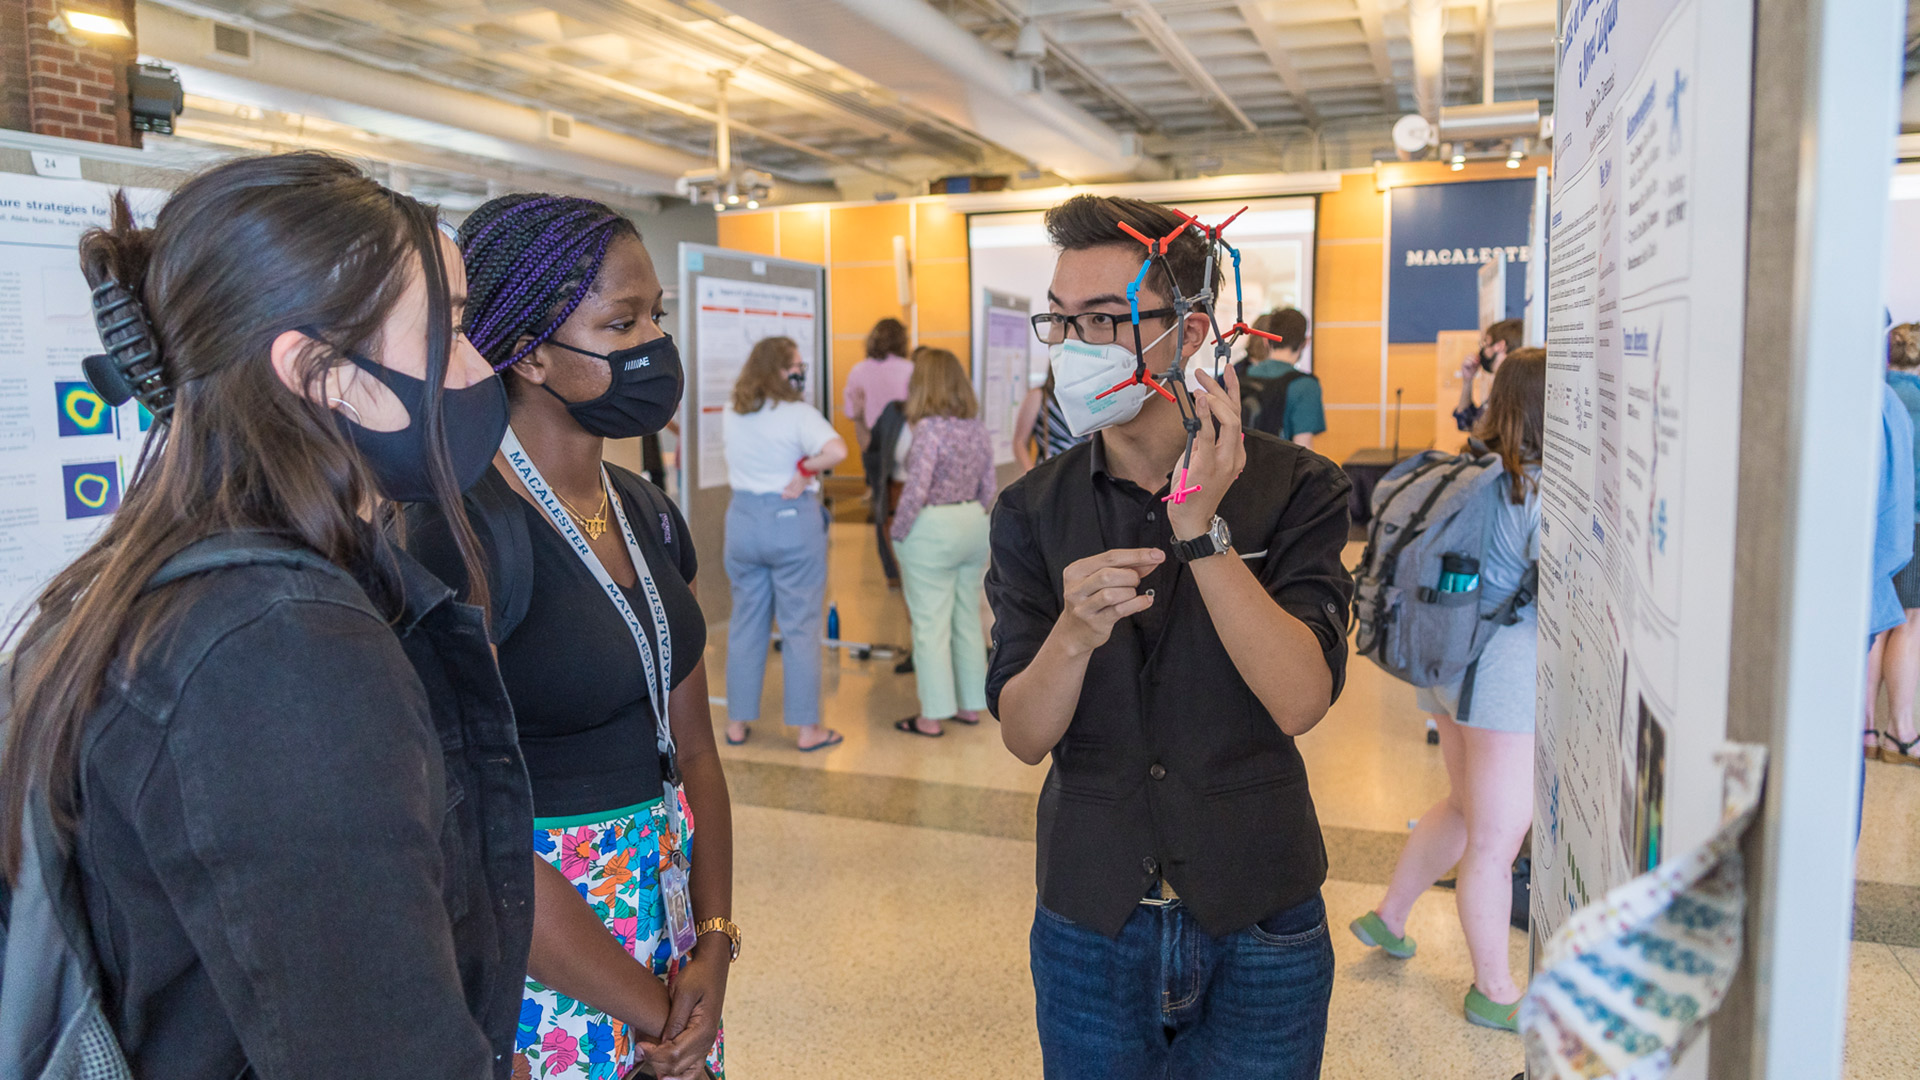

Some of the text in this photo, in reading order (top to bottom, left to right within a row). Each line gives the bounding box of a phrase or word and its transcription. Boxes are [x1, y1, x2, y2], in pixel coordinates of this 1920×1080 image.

[27, 201, 87, 215] strategies
[92, 204, 107, 216] for
[44, 158, 56, 169] 24
[509, 451, 590, 556] MACALESTER
[606, 582, 657, 693] MACALESTER
[643, 576, 672, 692] MACALESTER
